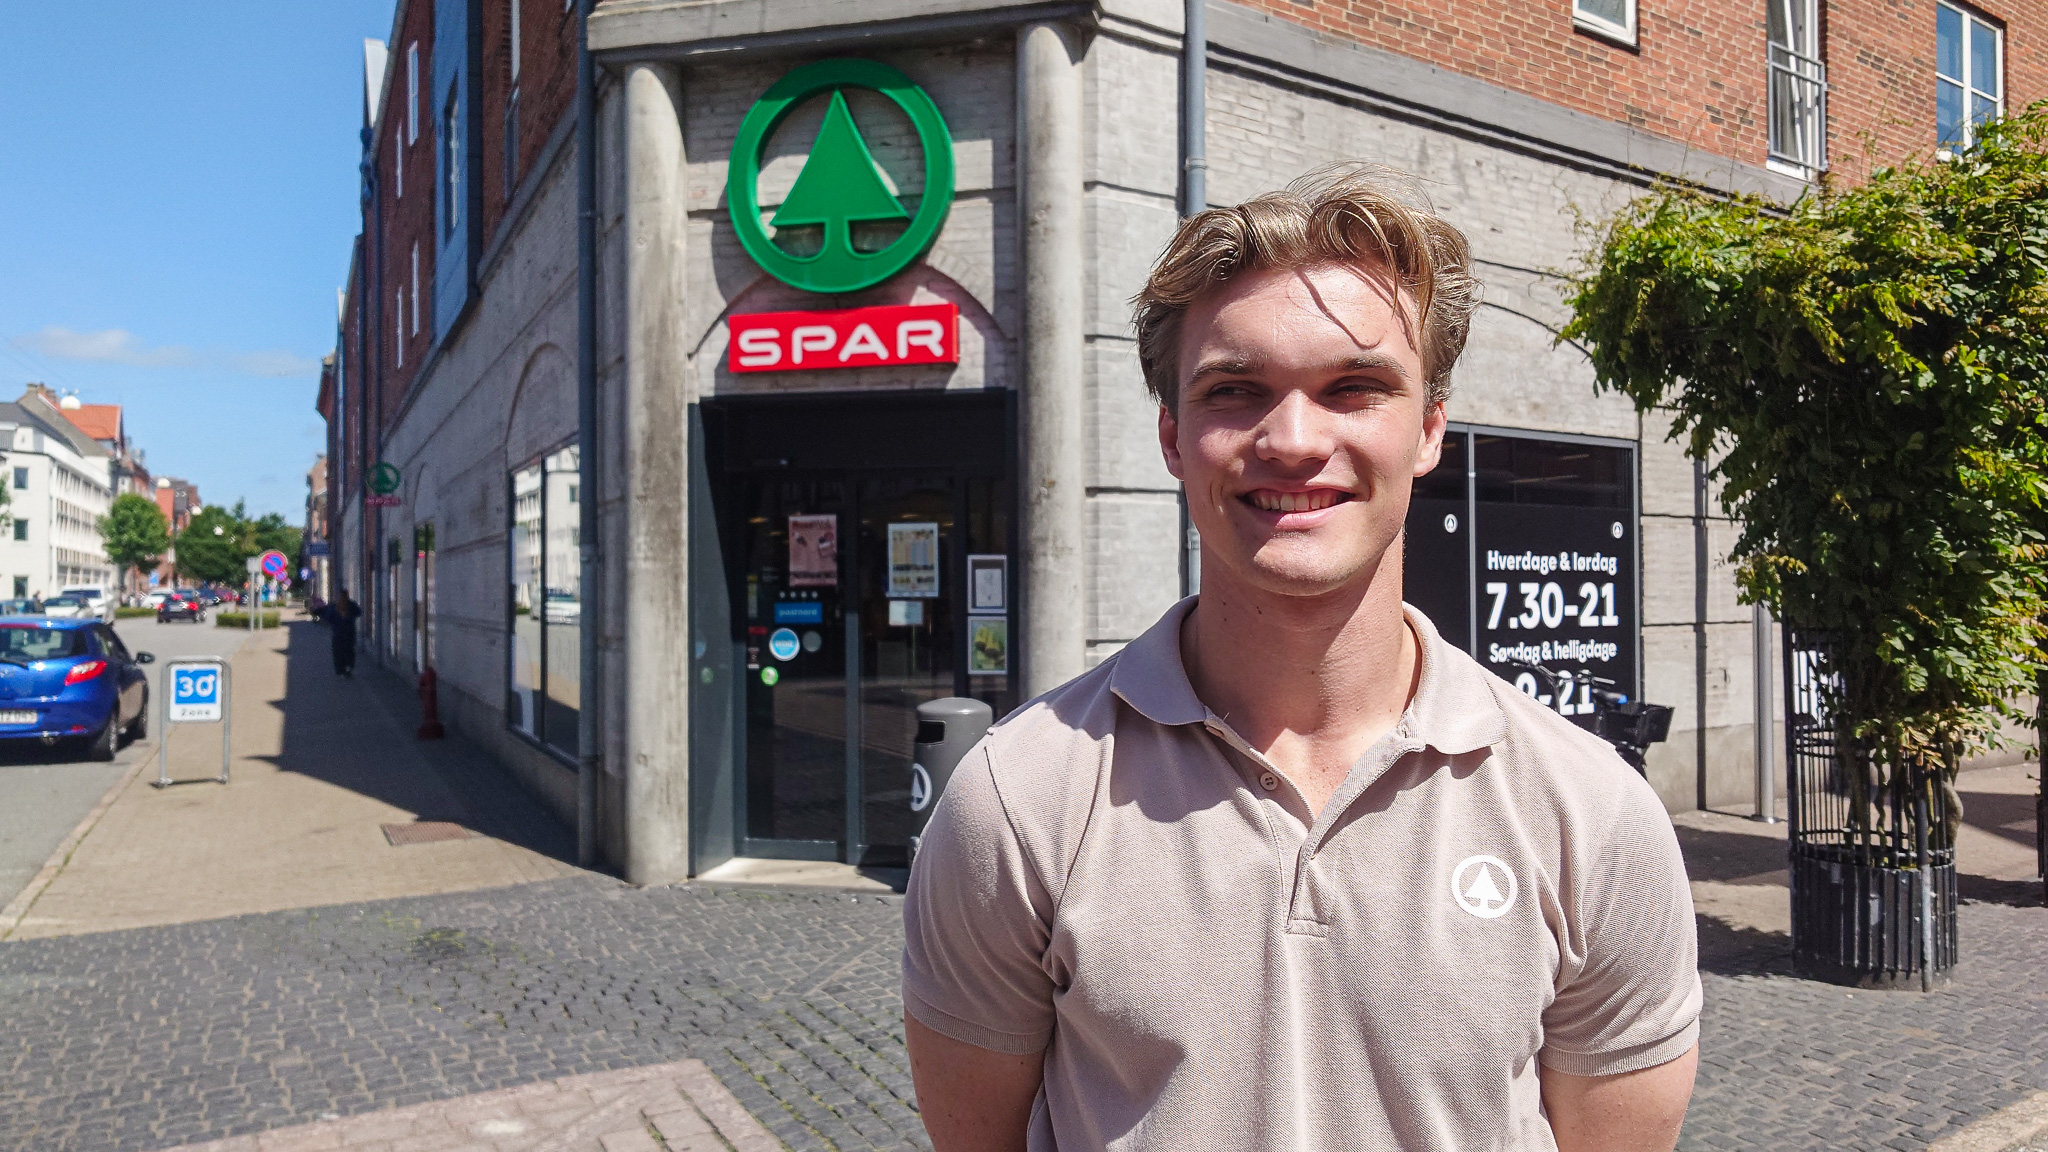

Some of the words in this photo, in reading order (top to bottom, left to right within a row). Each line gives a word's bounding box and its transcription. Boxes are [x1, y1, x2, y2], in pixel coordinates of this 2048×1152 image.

[738, 319, 945, 367] SPAR
[1486, 550, 1558, 576] Hverdage
[1560, 551, 1571, 571] &
[1572, 552, 1618, 576] lørdag
[1486, 581, 1620, 630] 7.30-21
[1489, 642, 1540, 665] Søndag
[1541, 640, 1554, 661] &
[1553, 639, 1618, 663] helligdage
[178, 675, 214, 698] 30
